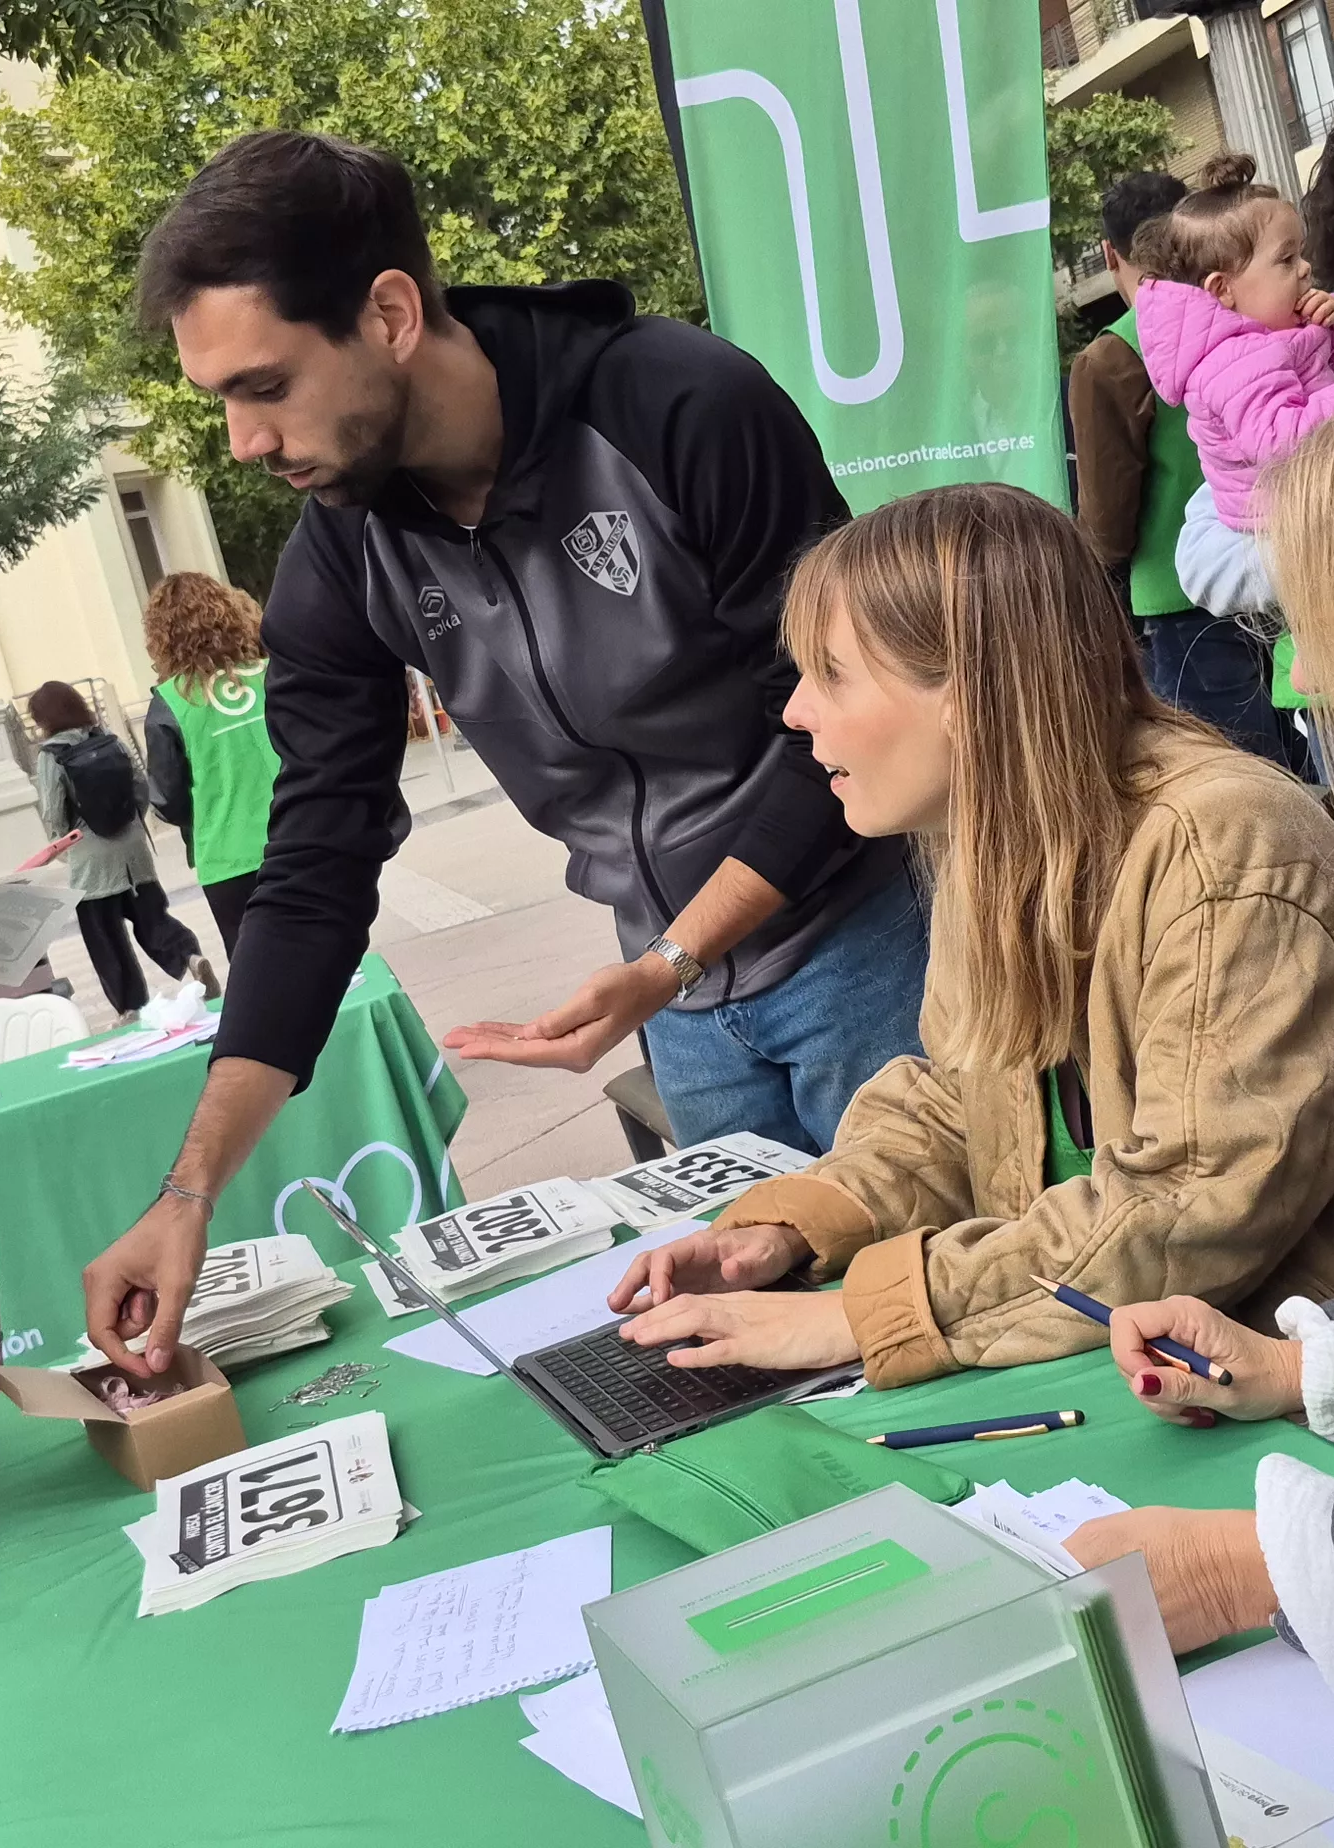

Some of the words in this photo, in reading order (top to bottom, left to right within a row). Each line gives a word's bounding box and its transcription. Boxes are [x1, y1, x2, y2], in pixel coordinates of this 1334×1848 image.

[604, 517, 629, 557] HUESCA
[658, 1152, 774, 1194] 2535
[465, 1196, 552, 1253] 2602
[200, 1478, 225, 1514] CÁNCER
[240, 1451, 329, 1546] 3671
[185, 1512, 201, 1539] HUESCA
[205, 1511, 225, 1526] EL
[205, 1521, 226, 1560] CONTRA
